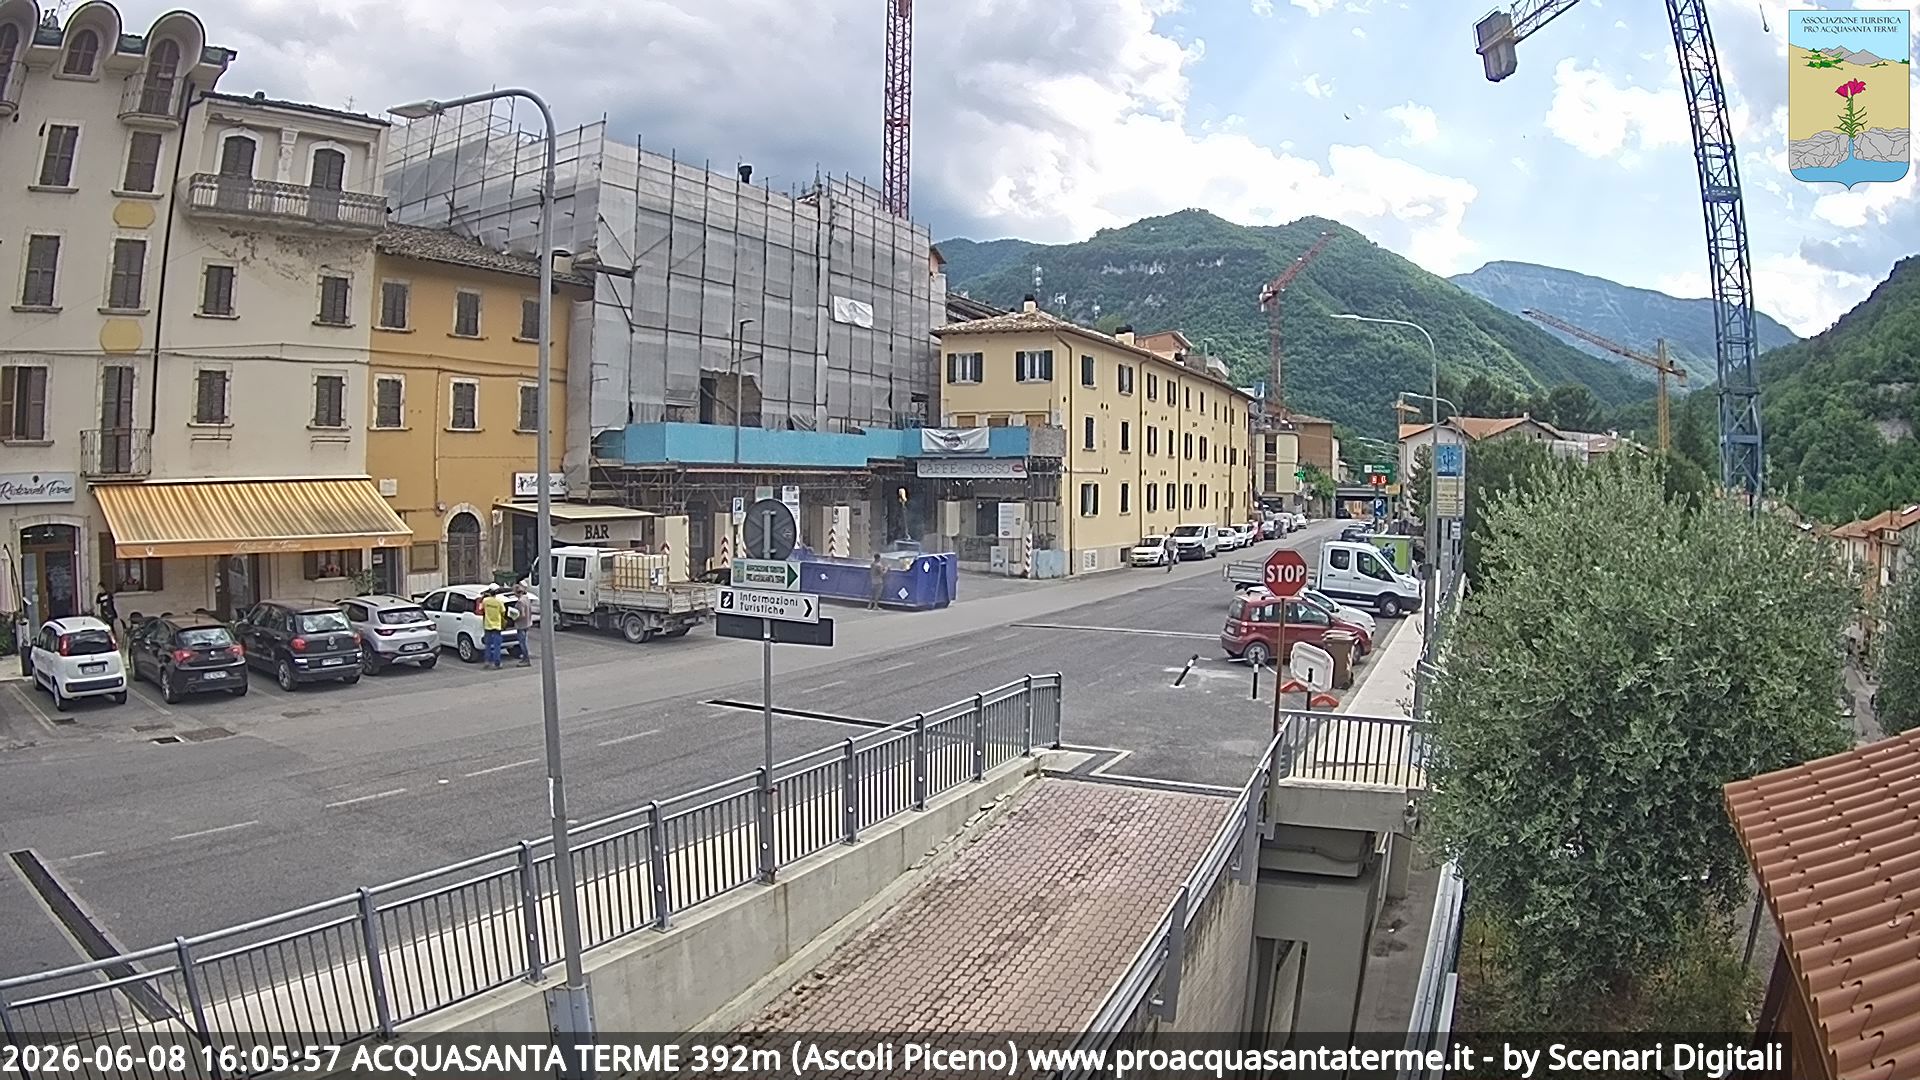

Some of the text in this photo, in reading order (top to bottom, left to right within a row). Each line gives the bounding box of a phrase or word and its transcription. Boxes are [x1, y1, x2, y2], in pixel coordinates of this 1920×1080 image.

[971, 463, 1010, 474] CORSO
[584, 524, 609, 540] BAR
[1266, 564, 1305, 583] STOP
[740, 592, 798, 606] Informazioni
[740, 601, 785, 615] Turistiche
